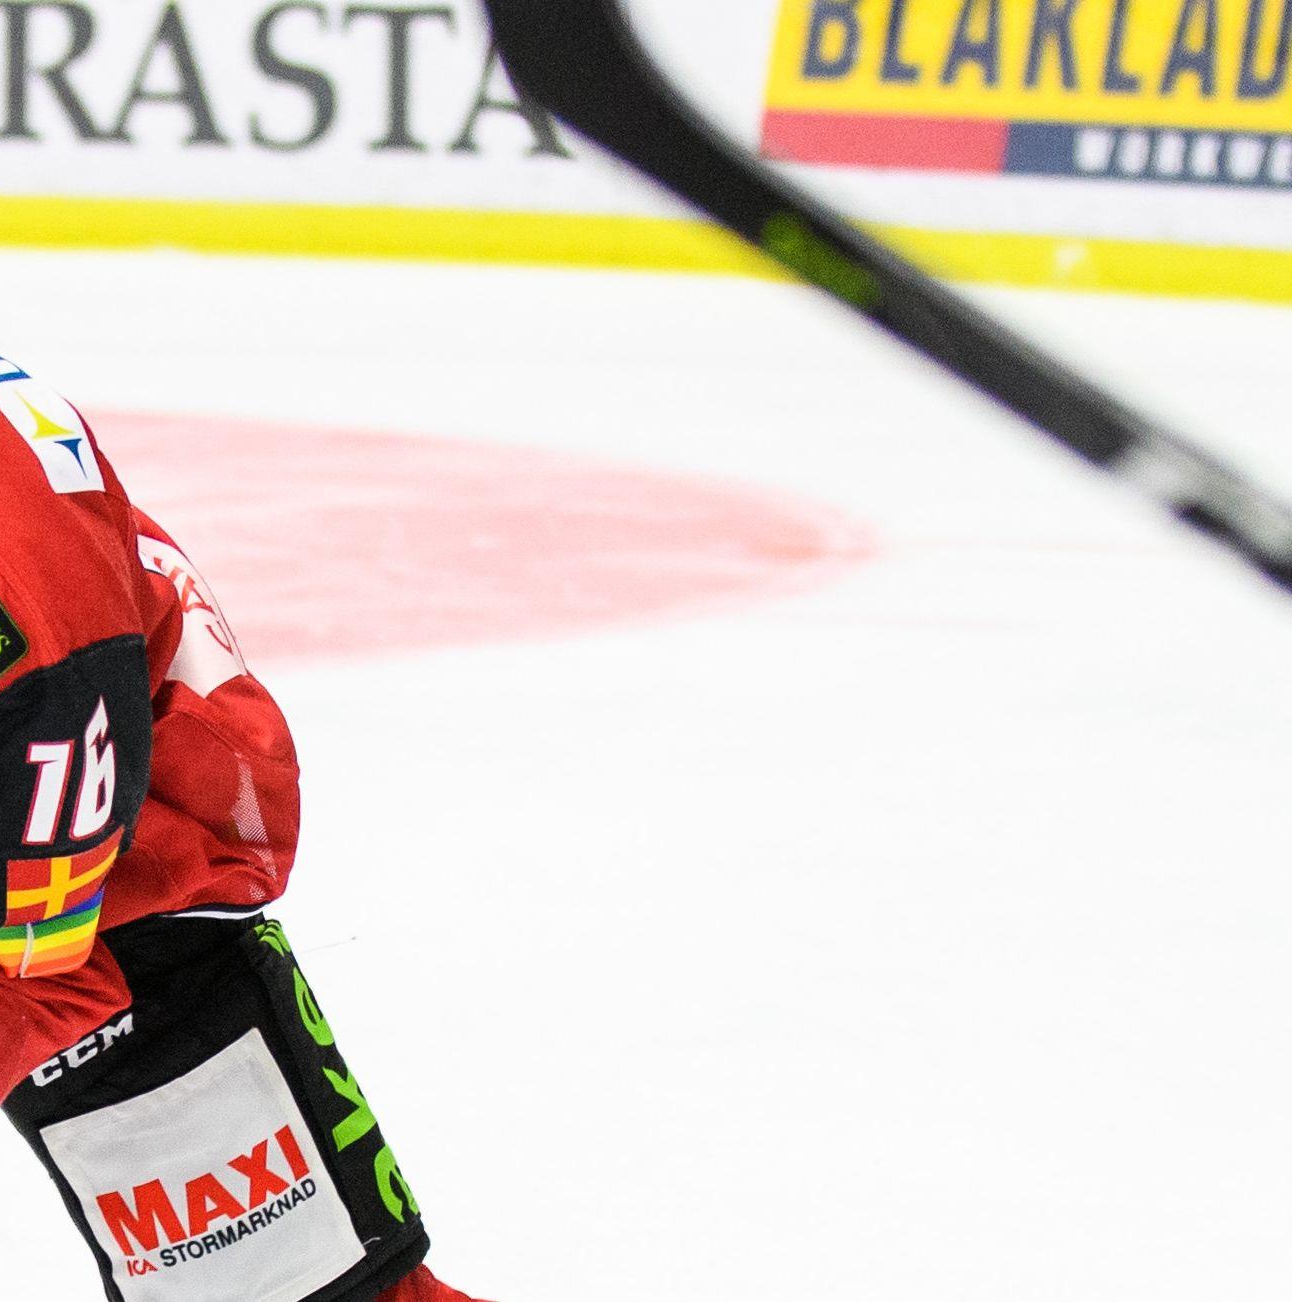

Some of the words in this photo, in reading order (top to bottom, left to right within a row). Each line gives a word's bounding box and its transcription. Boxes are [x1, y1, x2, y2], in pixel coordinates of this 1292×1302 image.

[21, 692, 117, 847] 16
[30, 1013, 135, 1088] CCM
[96, 1125, 310, 1257] MAXI
[160, 1177, 317, 1268] STORMARKNAD
